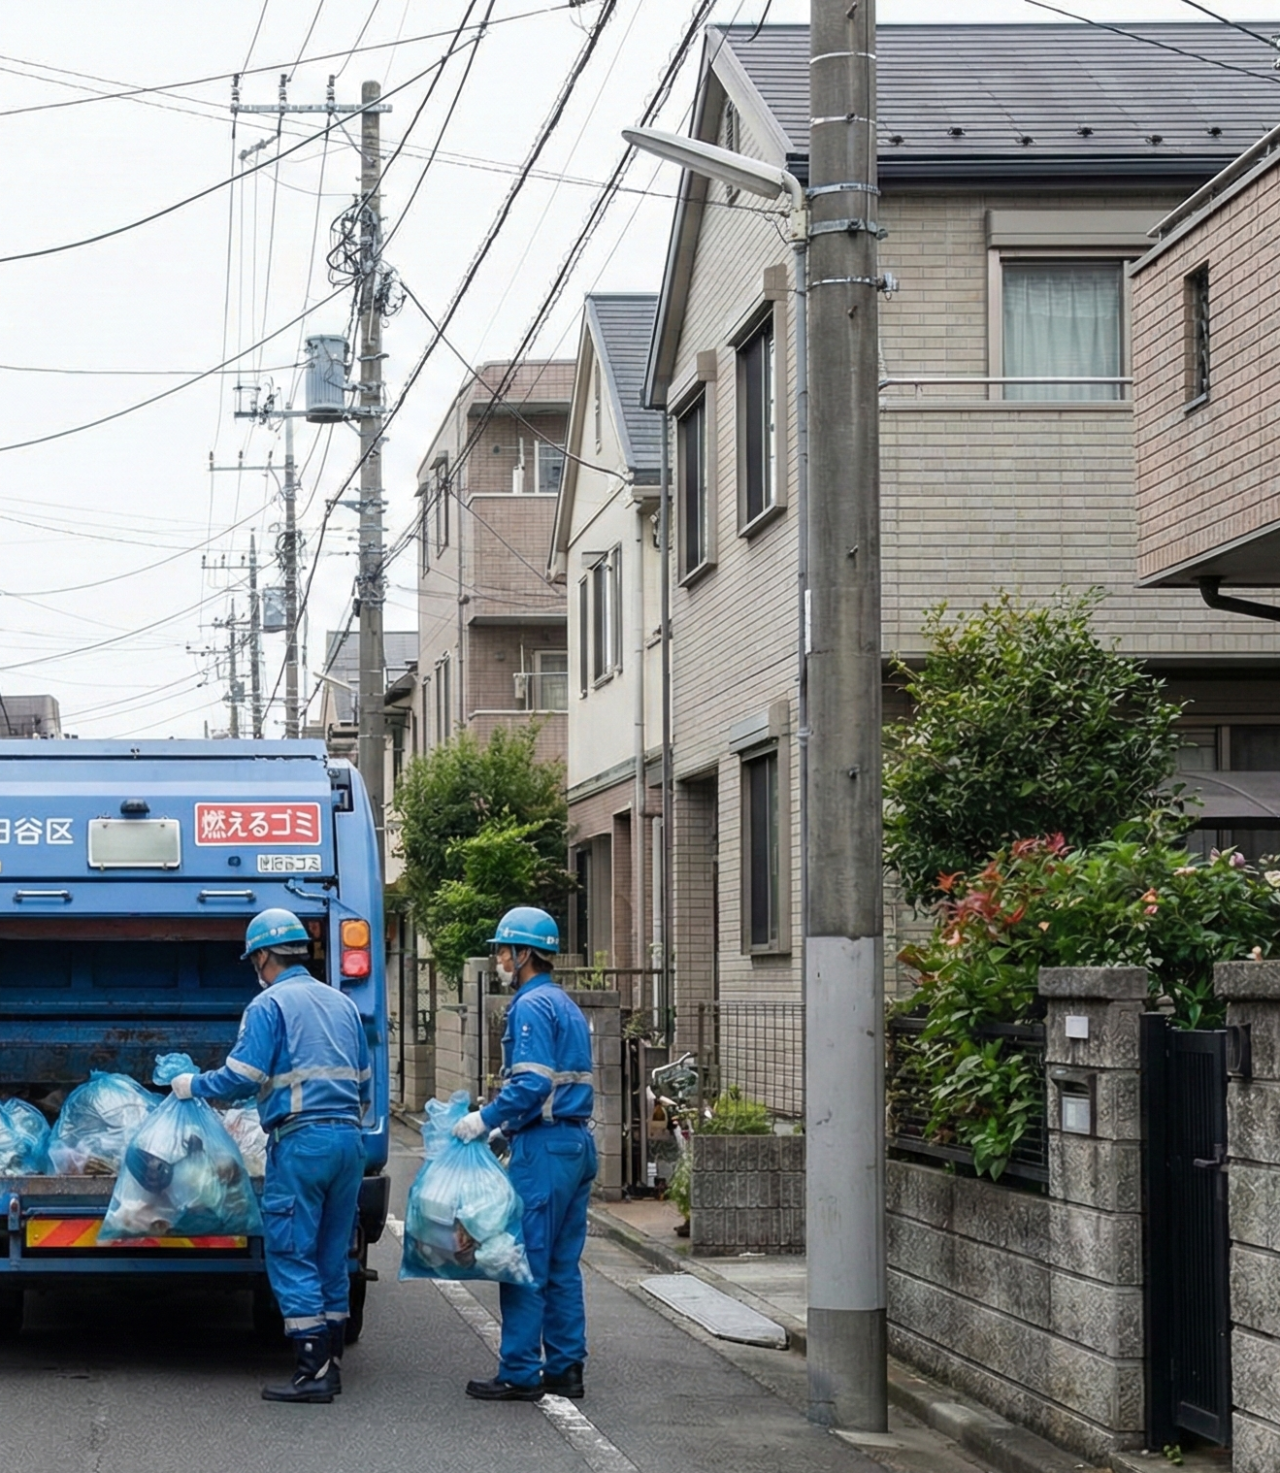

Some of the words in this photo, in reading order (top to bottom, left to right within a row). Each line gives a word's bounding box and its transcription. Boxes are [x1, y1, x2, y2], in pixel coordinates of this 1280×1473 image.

[201, 809, 314, 839] 燃えるゴミ
